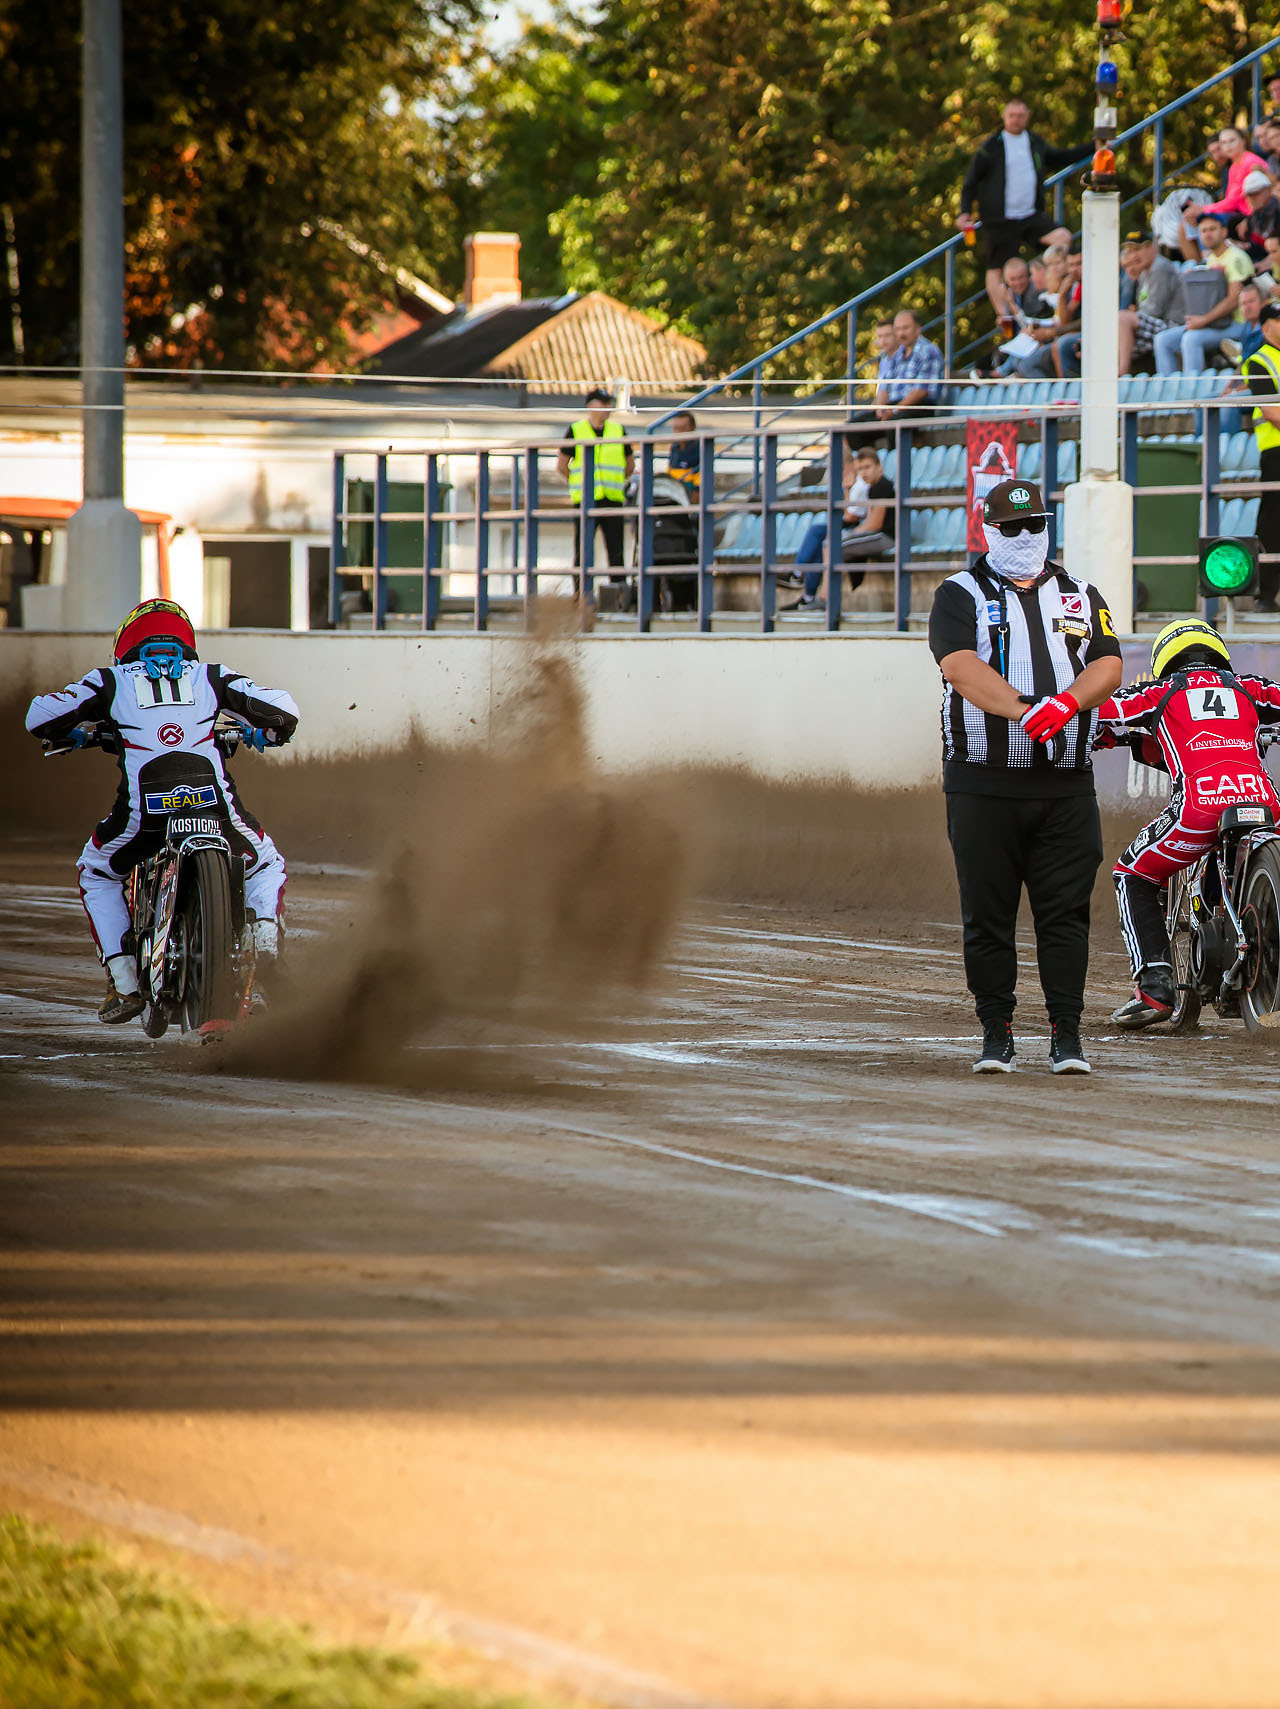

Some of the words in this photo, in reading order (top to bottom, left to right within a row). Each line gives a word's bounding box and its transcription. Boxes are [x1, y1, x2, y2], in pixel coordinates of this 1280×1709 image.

[1049, 697, 1070, 714] THOR
[1202, 690, 1226, 717] 4
[1195, 740, 1222, 748] INVEST
[1196, 774, 1259, 795] CAR
[162, 792, 205, 809] REALL
[1198, 794, 1260, 806] GWARANT
